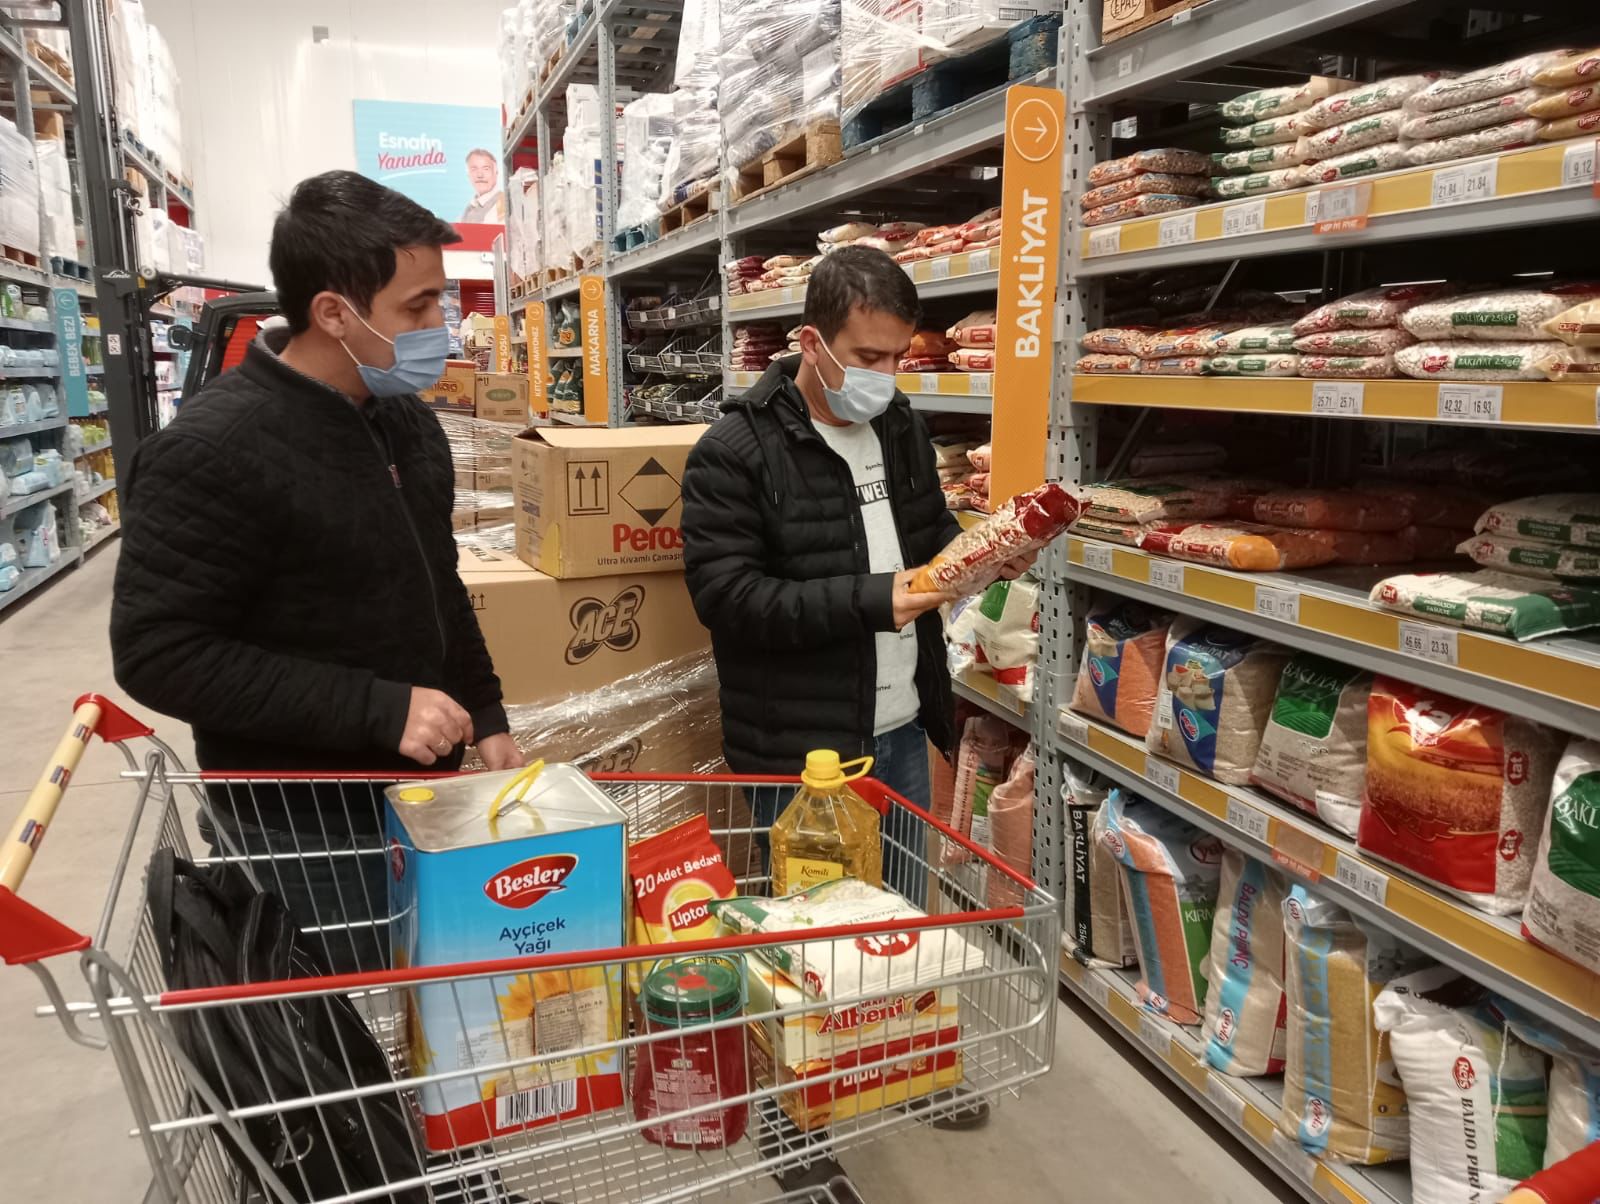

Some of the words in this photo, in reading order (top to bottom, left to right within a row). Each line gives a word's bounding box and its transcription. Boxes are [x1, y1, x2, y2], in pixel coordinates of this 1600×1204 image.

[379, 132, 442, 151] Esnafın
[378, 148, 447, 170] Yanında
[1013, 189, 1048, 358] BAKLİYAT
[587, 309, 601, 376] MAKARNA
[67, 343, 80, 377] BEBEK
[597, 557, 618, 566] Ultra
[620, 554, 651, 565] Kıvamlı
[570, 600, 637, 650] ACE
[1072, 810, 1088, 884] BAKLİYAT
[495, 866, 566, 899] Besler
[635, 874, 656, 899] 20
[656, 866, 683, 885] Adet
[801, 865, 829, 878] Komili
[499, 917, 566, 943] Ayçiçek
[515, 938, 551, 957] Yağı
[816, 997, 905, 1037] Albeni
[1461, 1097, 1478, 1151] BALDO
